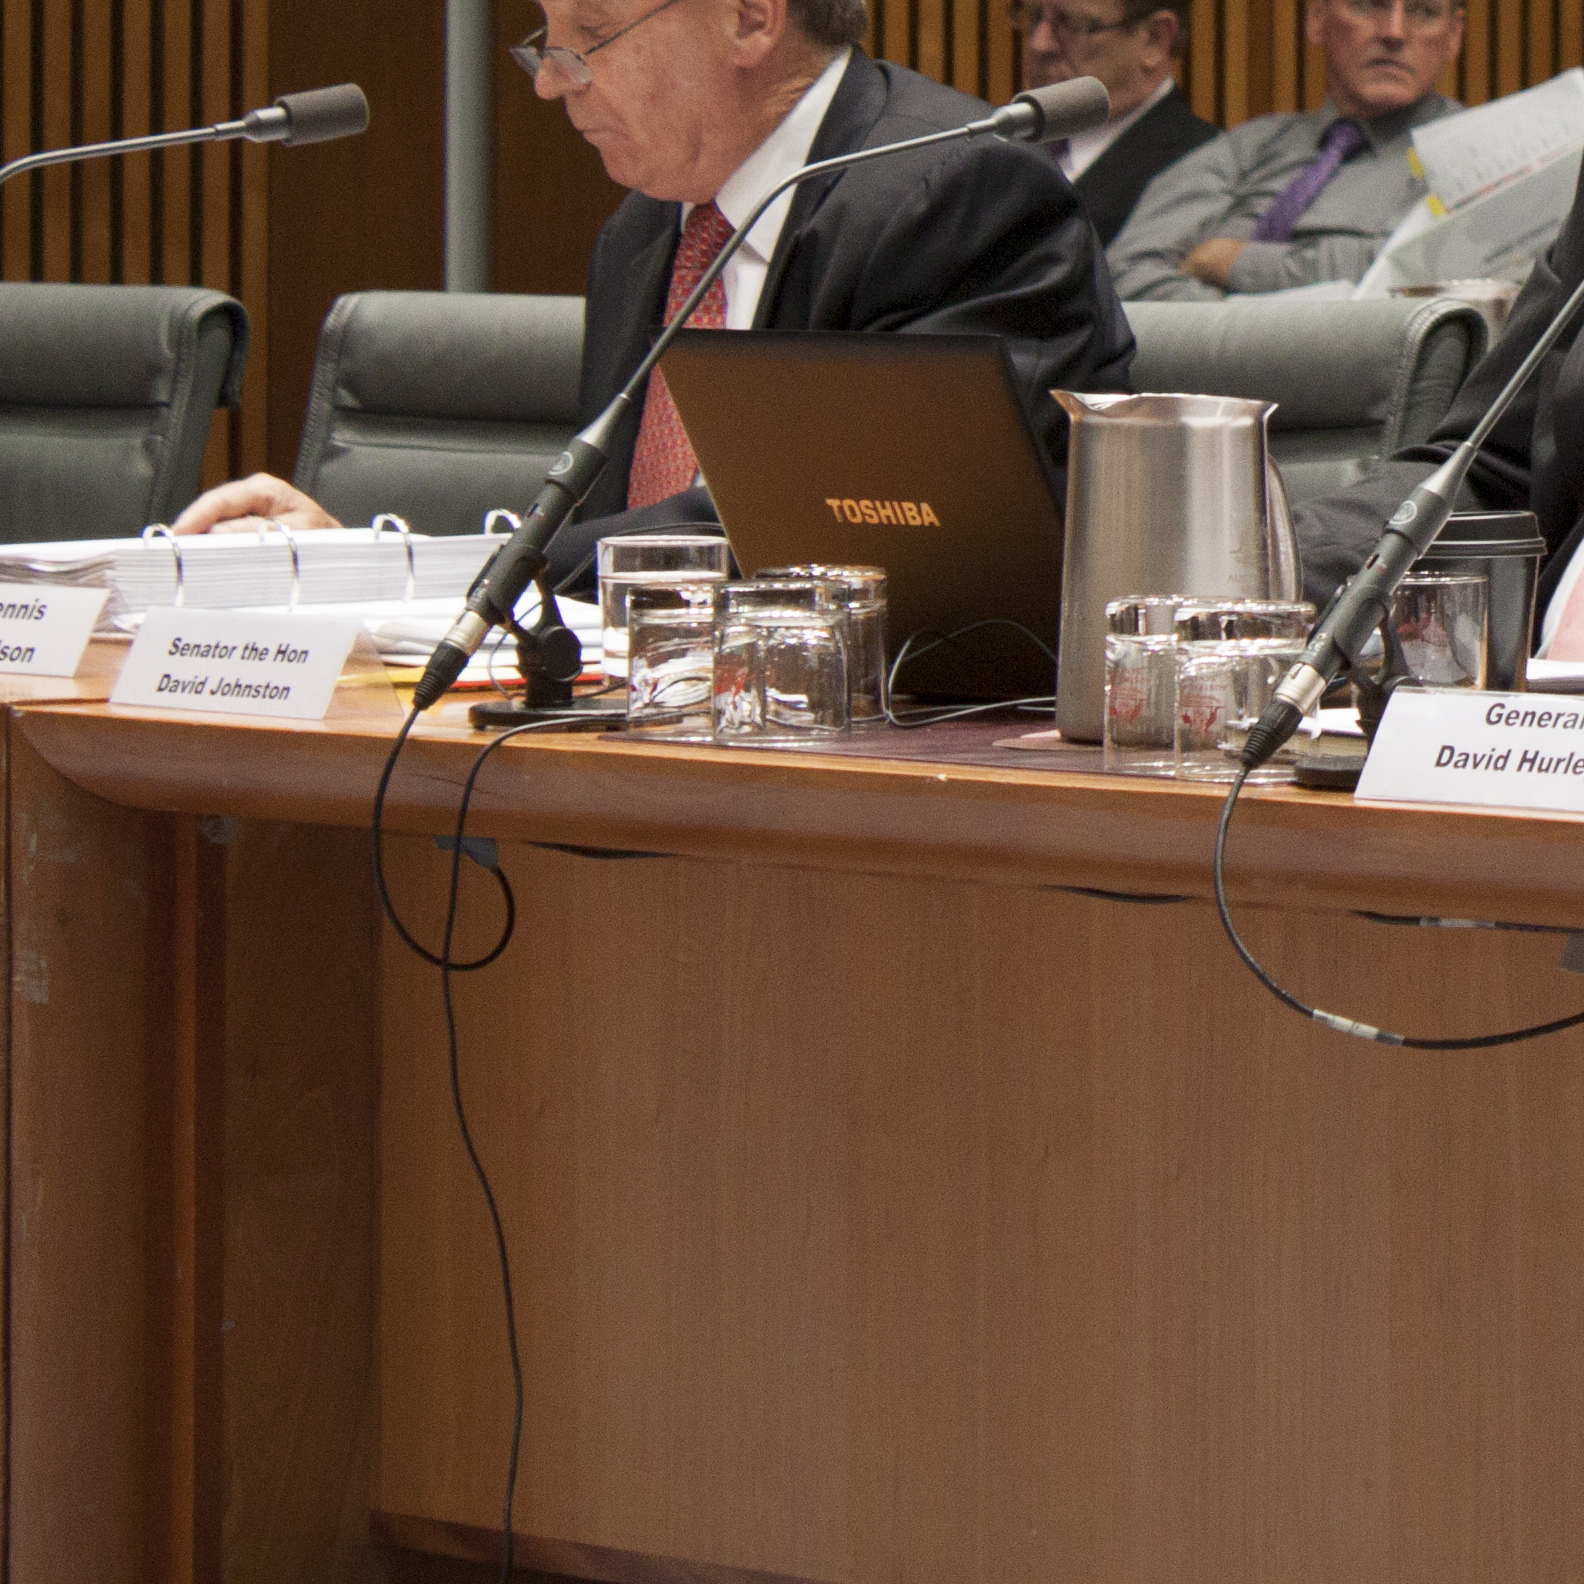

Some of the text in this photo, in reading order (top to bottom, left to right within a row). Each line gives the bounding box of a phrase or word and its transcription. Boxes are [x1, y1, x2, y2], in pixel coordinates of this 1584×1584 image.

[825, 498, 941, 527] TOSHIBA
[0, 639, 36, 663] son
[168, 636, 310, 664] Senator the Hon
[156, 673, 291, 701] David Johnston
[1433, 744, 1513, 773] David
